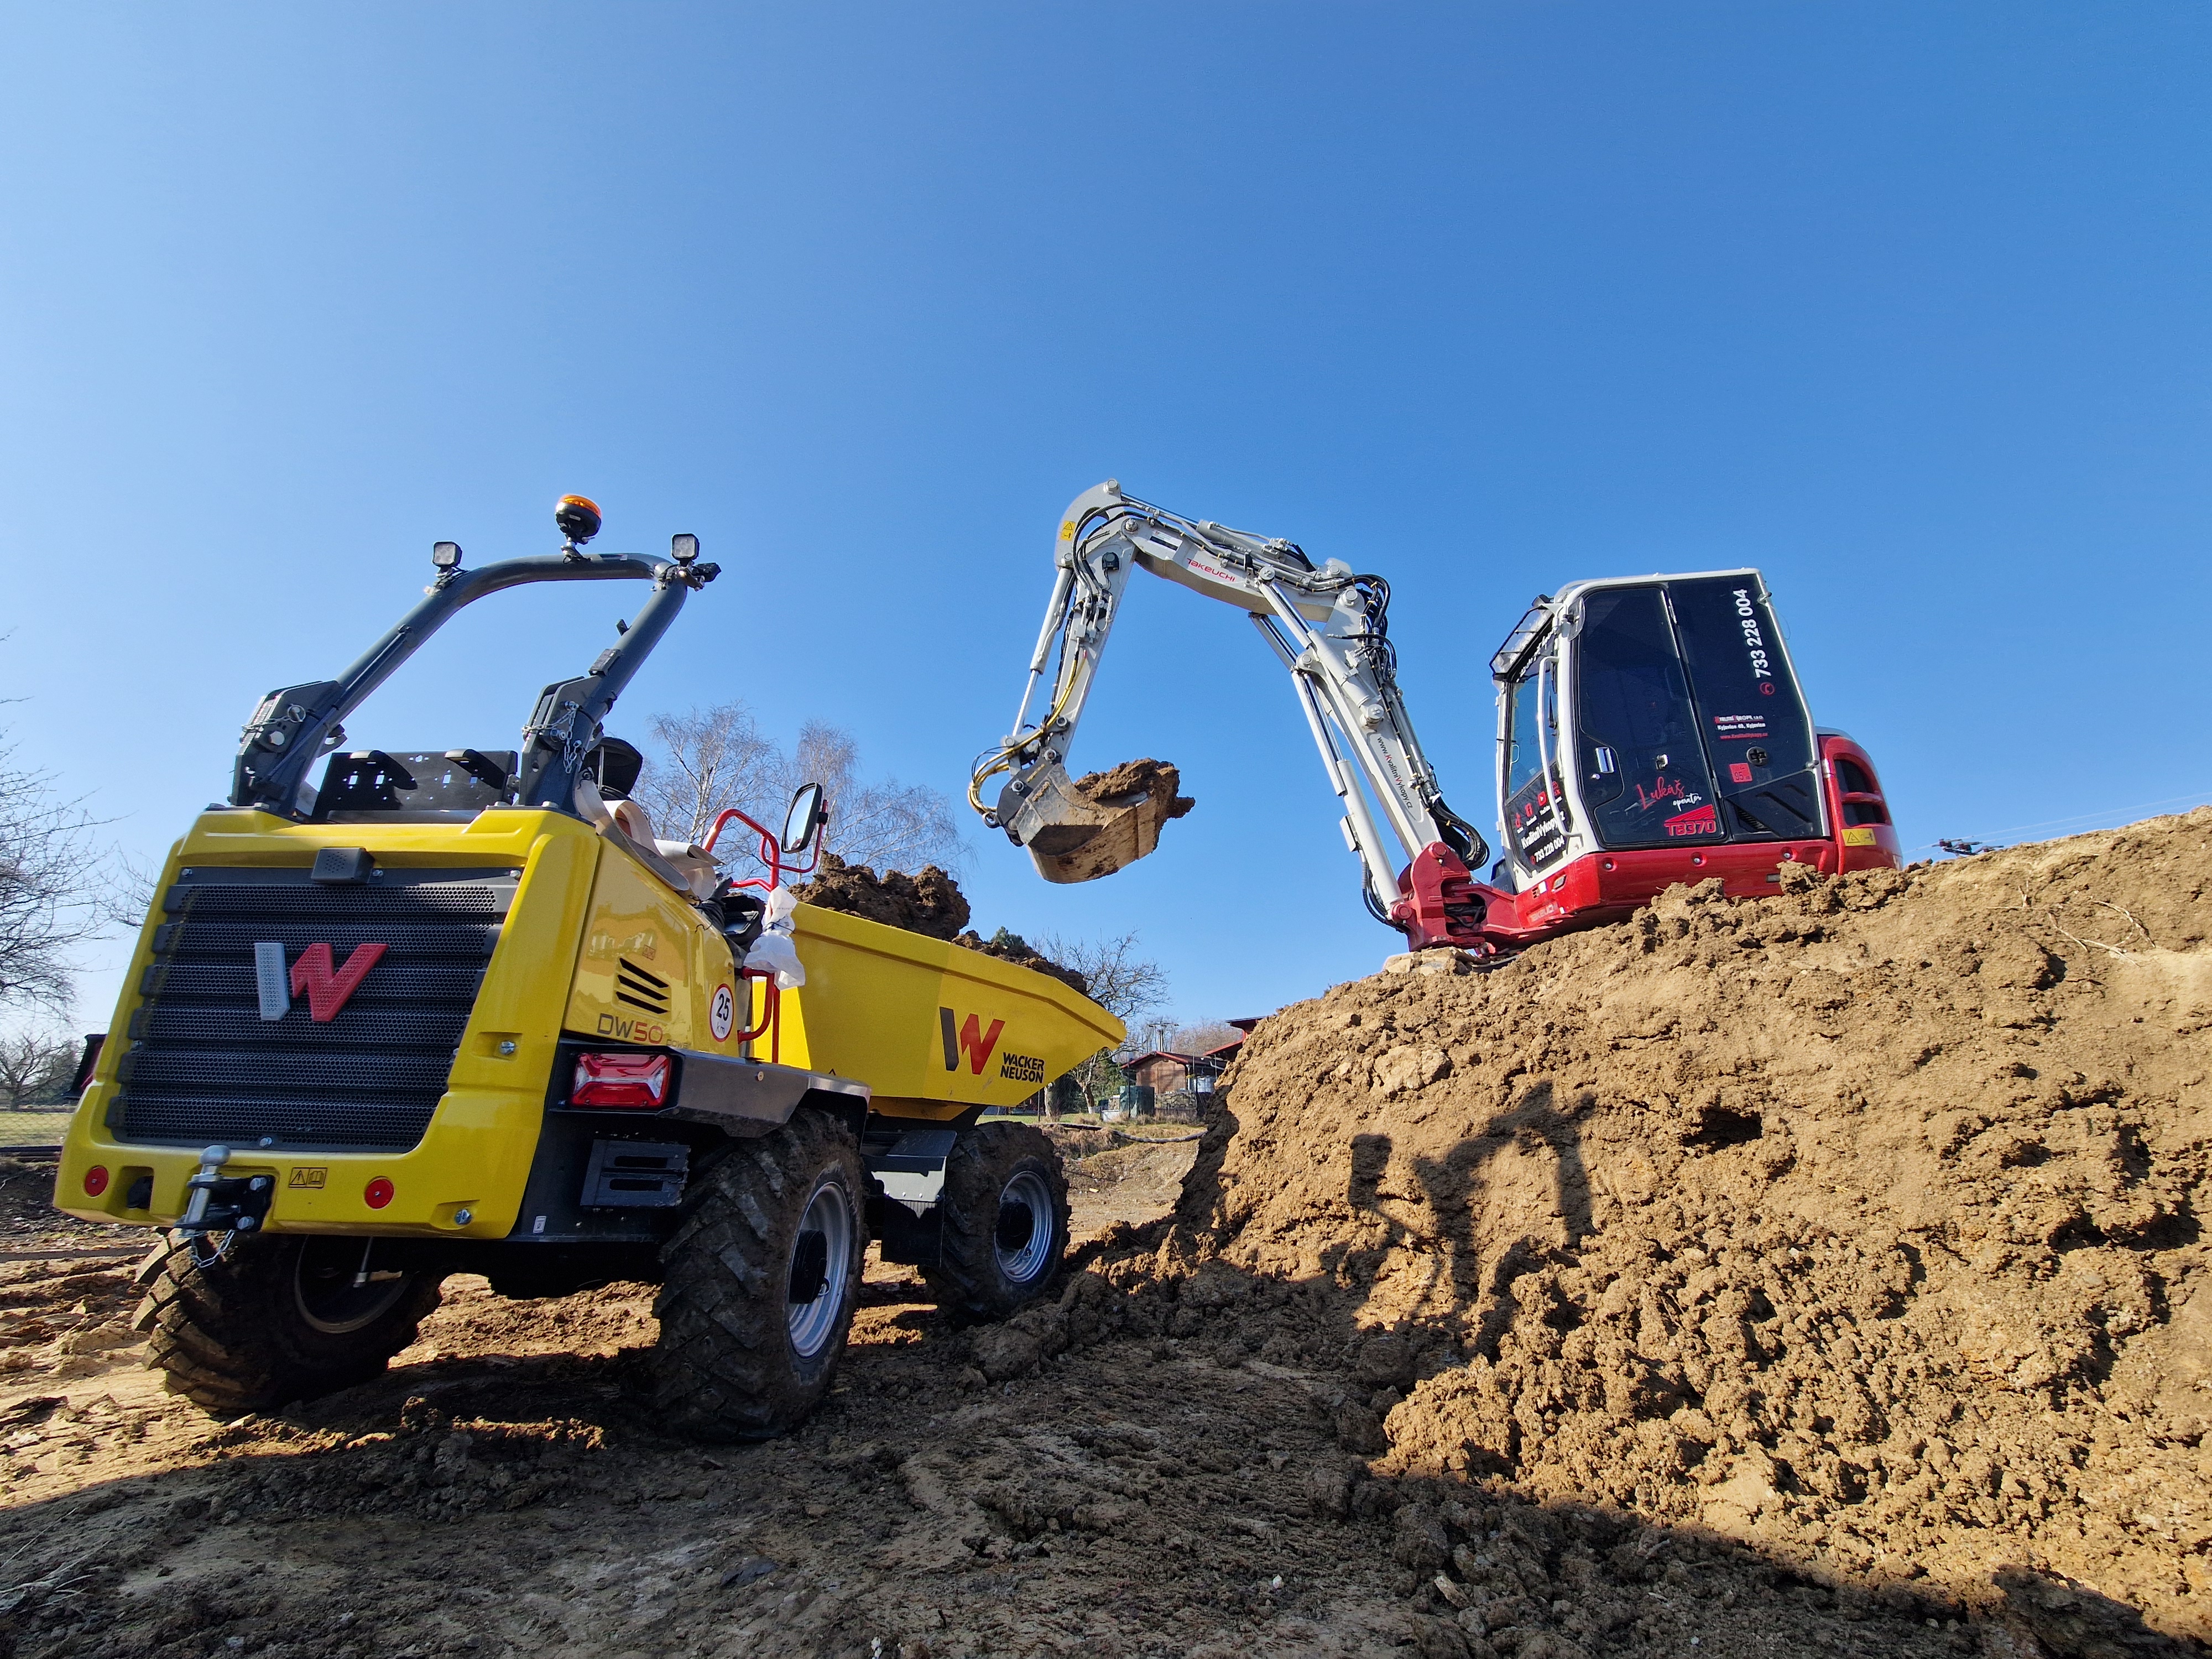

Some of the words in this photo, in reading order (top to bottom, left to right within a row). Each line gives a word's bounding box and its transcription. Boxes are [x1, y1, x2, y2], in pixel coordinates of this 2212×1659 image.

[1733, 588, 1753, 617] 004
[1741, 619, 1763, 647] 228
[1750, 649, 1772, 679] 733
[1636, 776, 1684, 811] Lukáš
[1664, 820, 1717, 836] TB370
[1534, 847, 1545, 863] 733
[1544, 842, 1554, 857] 228
[1553, 835, 1565, 851] 004
[716, 993, 731, 1021] 25
[597, 1013, 663, 1045] DW50
[716, 1022, 725, 1035] km
[1000, 1065, 1044, 1083] NEUSON
[1003, 1052, 1045, 1071] WACKER
